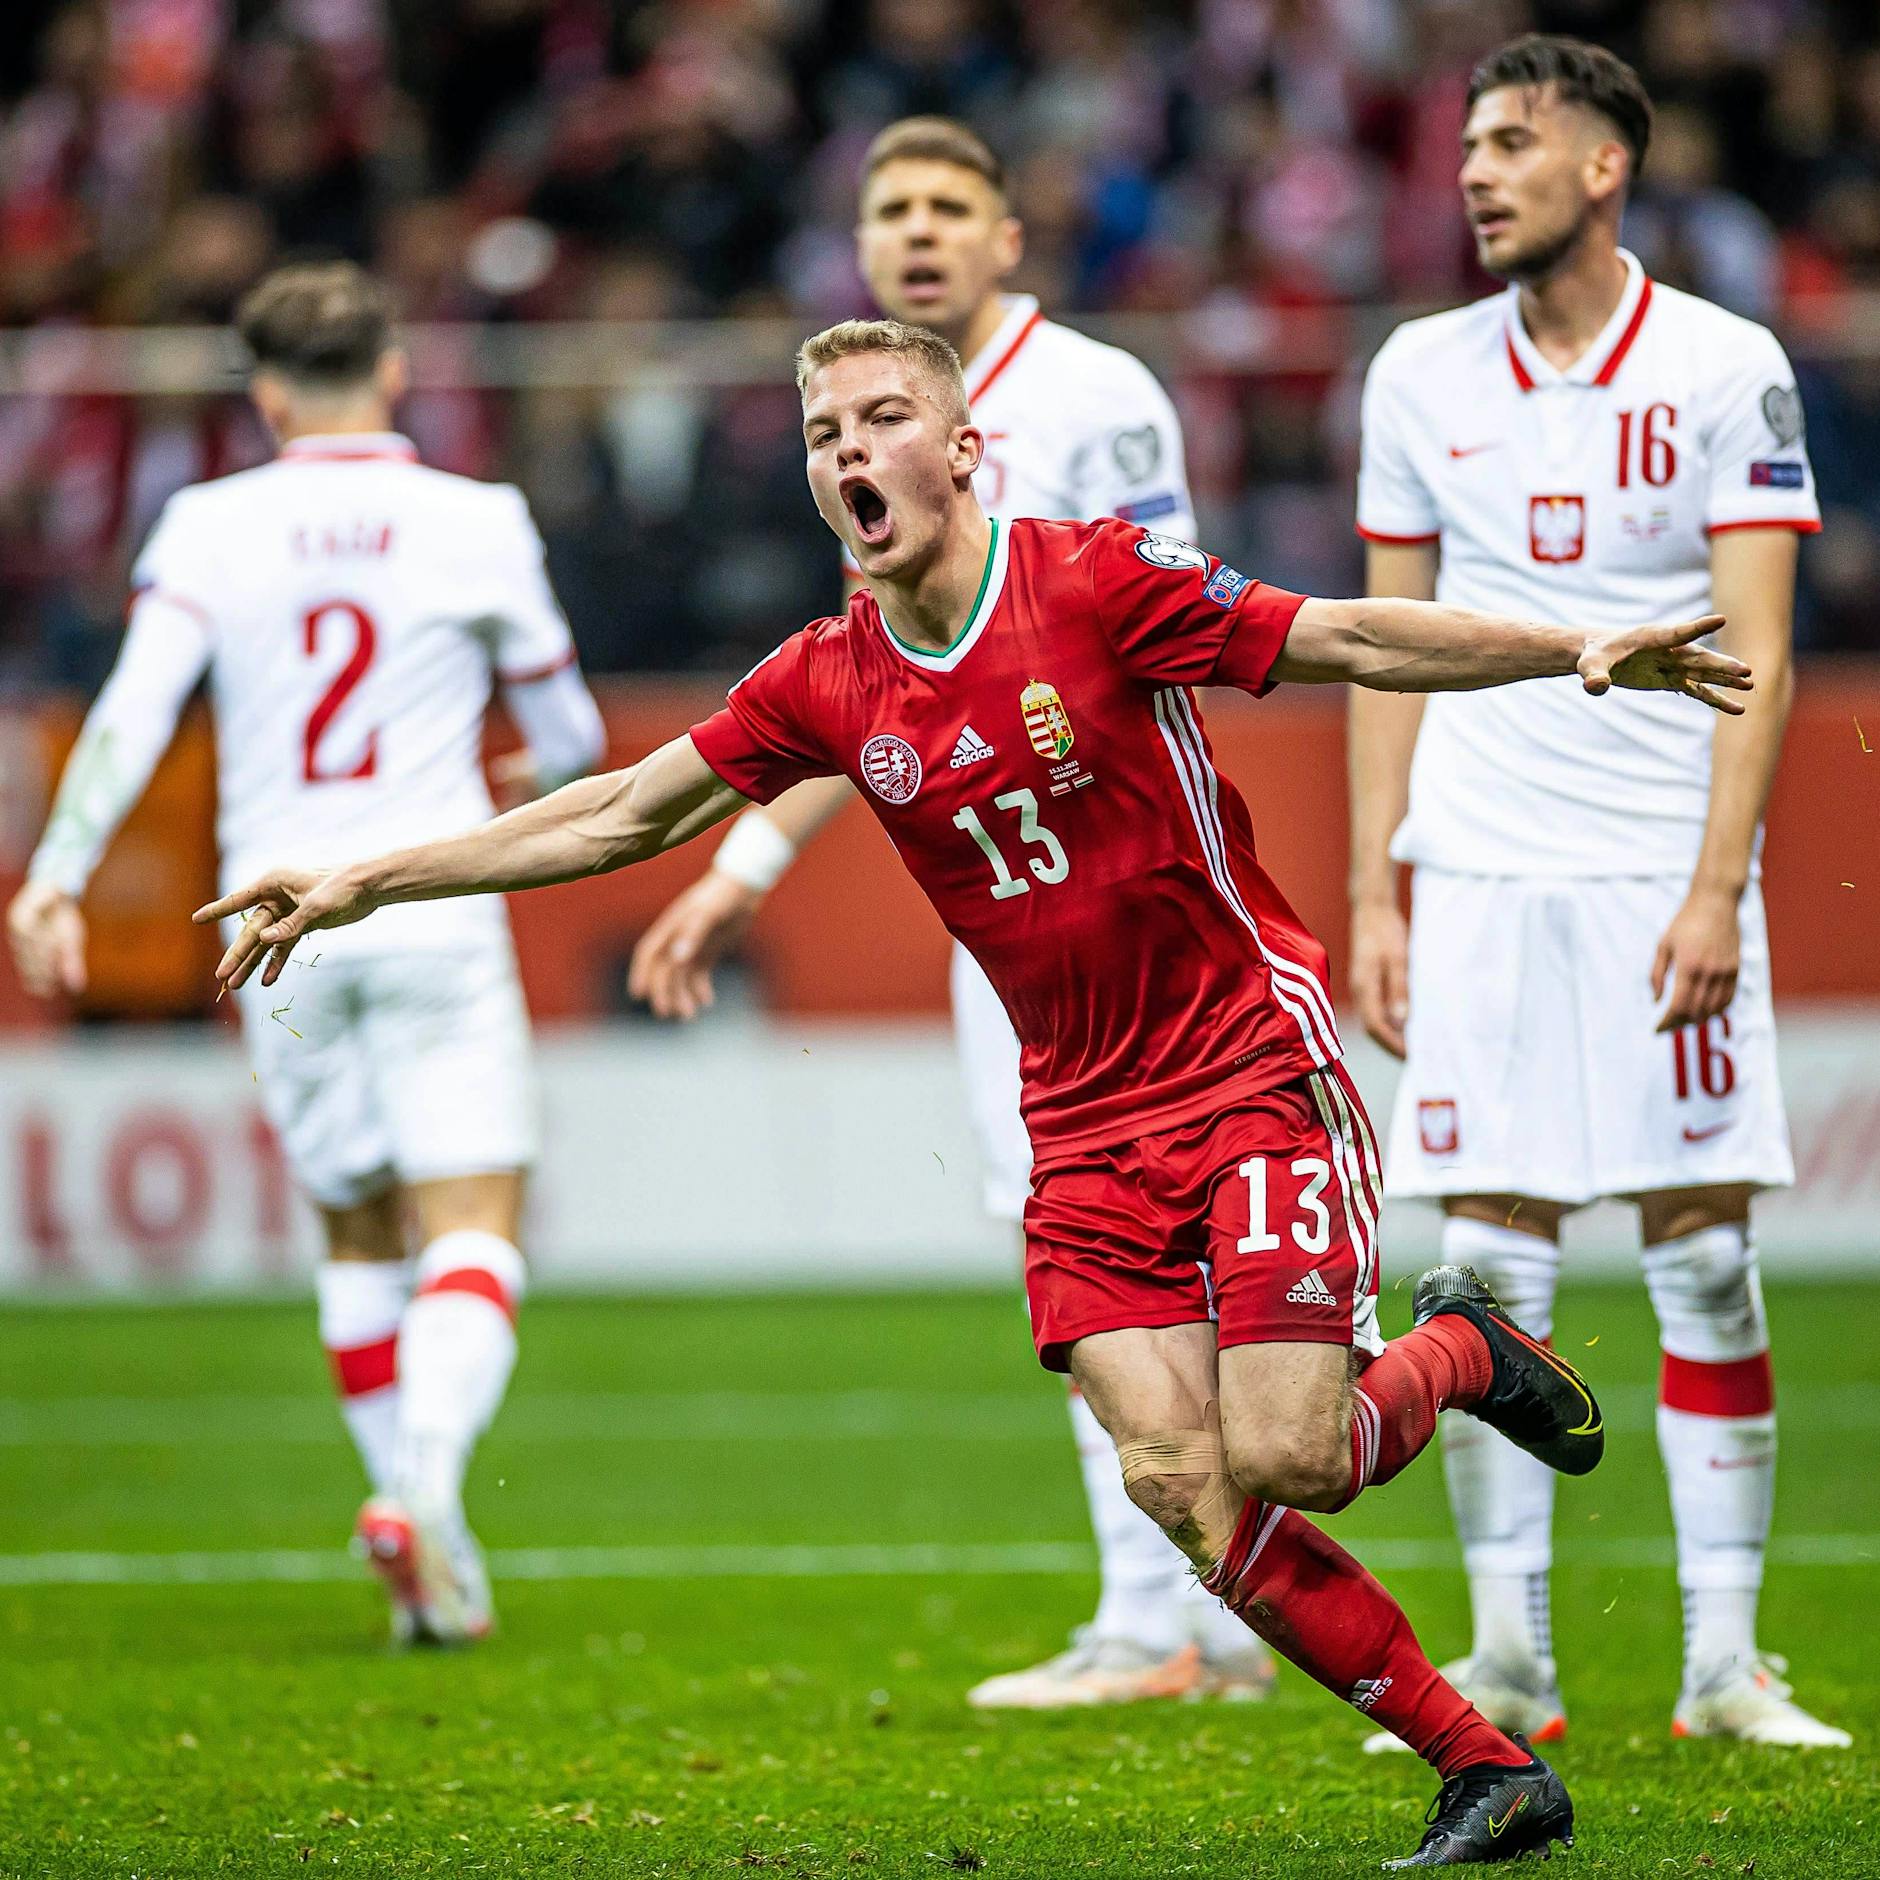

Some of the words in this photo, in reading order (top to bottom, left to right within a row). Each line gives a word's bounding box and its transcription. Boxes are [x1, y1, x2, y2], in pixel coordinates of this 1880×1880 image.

[1617, 402, 1678, 489] 16
[304, 599, 379, 783] 2
[949, 744, 995, 769] adidas
[1052, 767, 1080, 780] WARSAW
[952, 787, 1070, 900] 13
[1673, 1014, 1736, 1100] 16
[1236, 1156, 1331, 1254] 13
[1285, 1291, 1338, 1307] adidas
